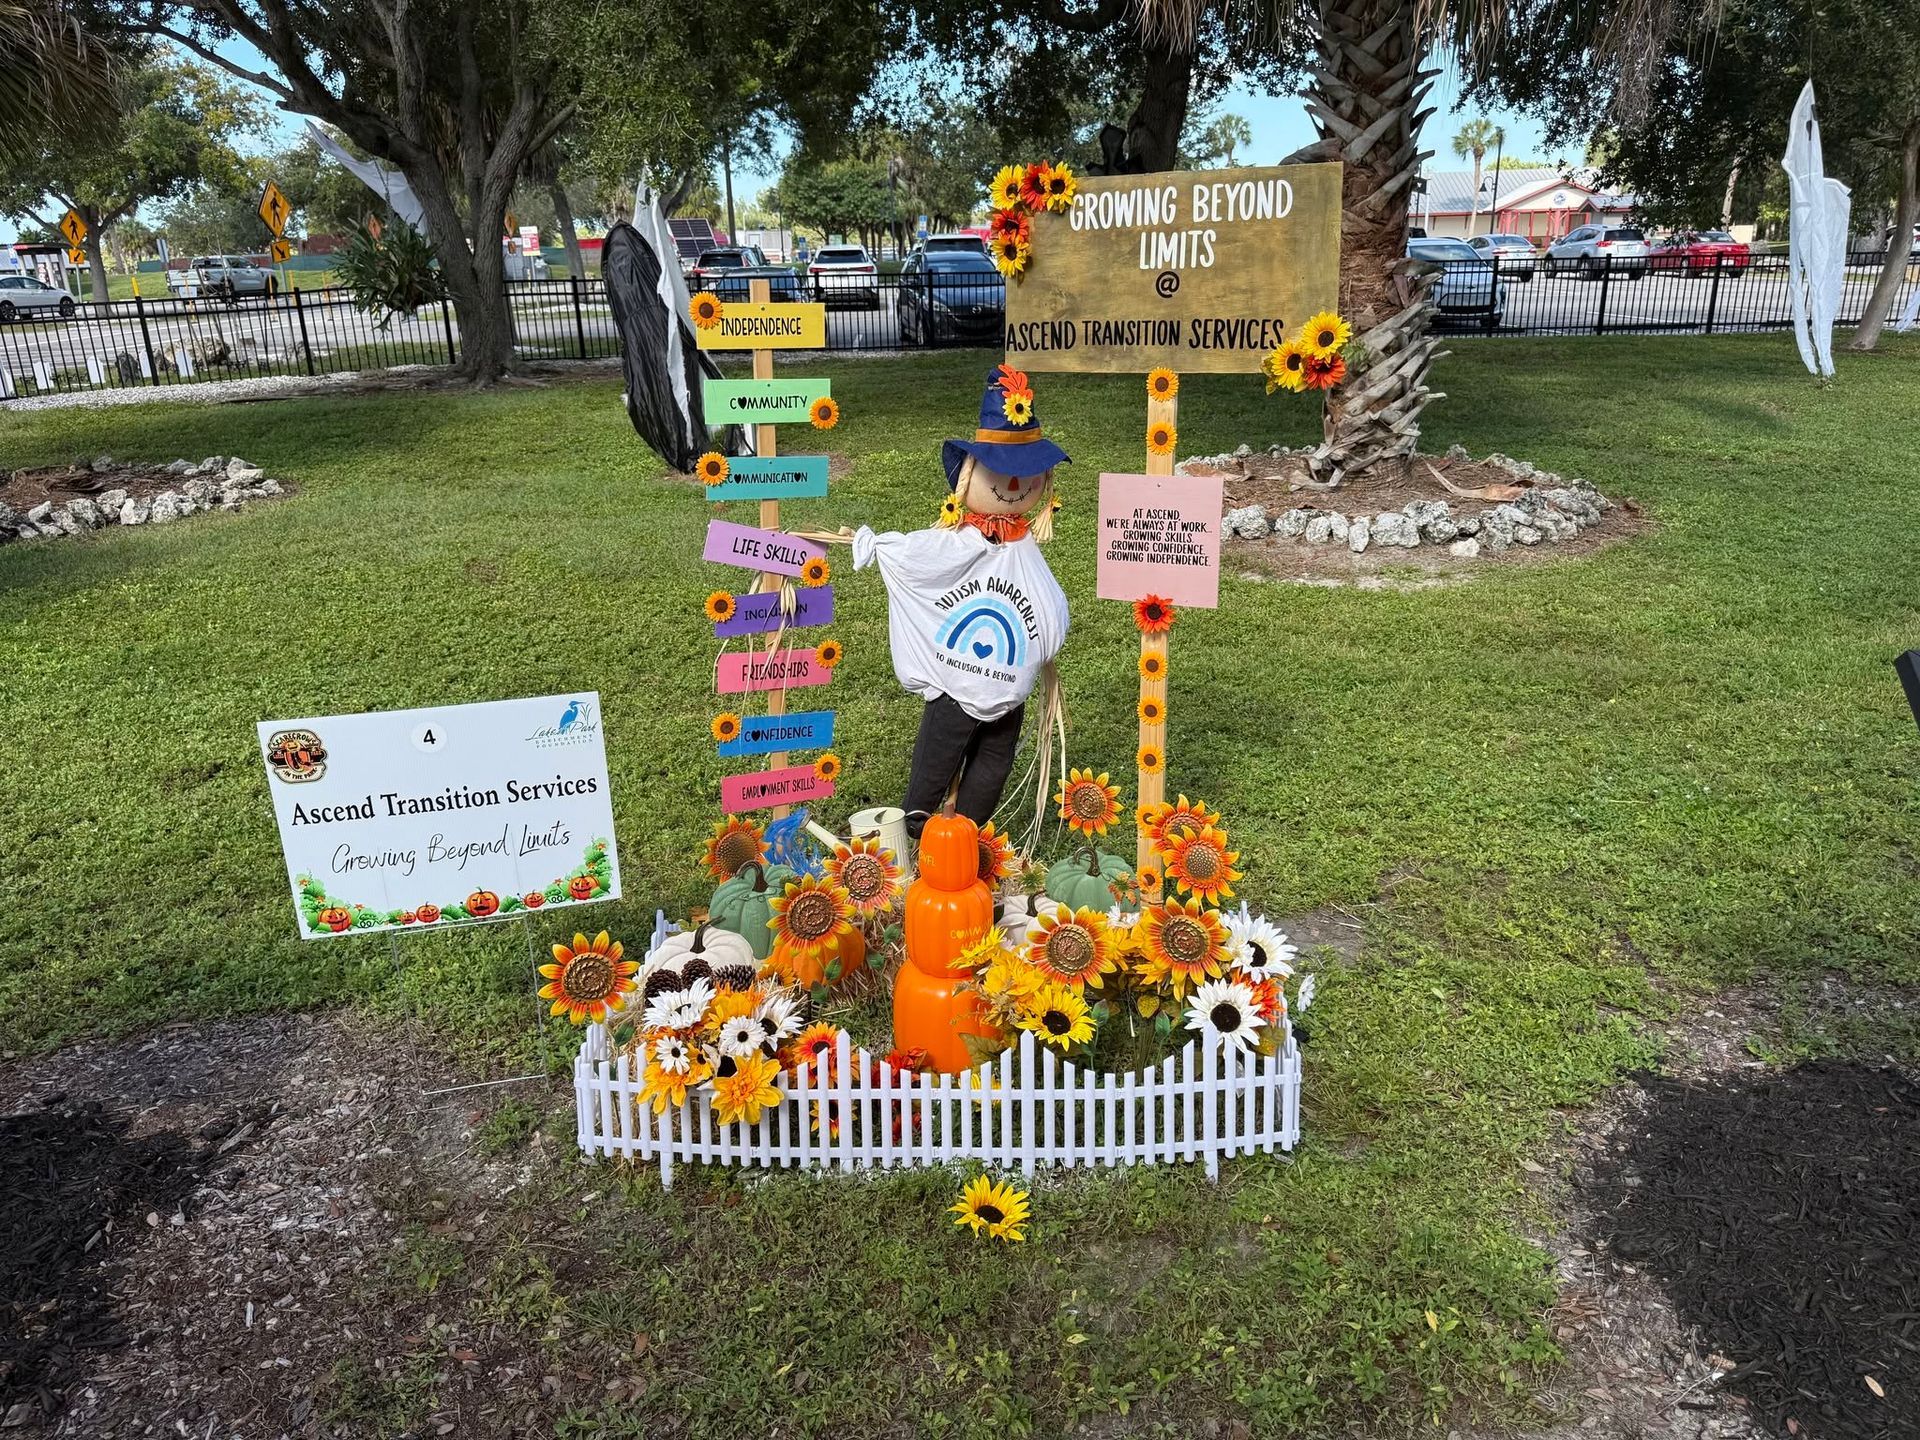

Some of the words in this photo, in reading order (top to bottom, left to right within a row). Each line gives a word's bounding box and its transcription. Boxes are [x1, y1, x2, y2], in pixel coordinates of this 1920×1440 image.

[1069, 185, 1177, 232] GROWING
[1193, 179, 1293, 224] BEYOND
[1139, 229, 1216, 270] LIMITS
[1155, 271, 1180, 298] @
[720, 317, 802, 336] INDEPENDENCE
[1005, 320, 1076, 351] ASCEND
[1082, 319, 1181, 348] TRANSITION
[1188, 318, 1285, 350] SERVICES
[1106, 518, 1130, 529] WE'RE
[1132, 520, 1164, 531] ALWAYS
[1167, 521, 1178, 531] AT
[1133, 508, 1143, 519] AT
[1111, 540, 1150, 552] GROWING
[1123, 530, 1162, 541] GROWING
[732, 537, 761, 557] LIFE
[763, 543, 807, 566] SKILLS
[1106, 550, 1144, 563] GROWING
[934, 579, 982, 611] AUTISM
[936, 652, 945, 662] TO
[946, 657, 983, 675] INCLUSION
[984, 668, 990, 677] &
[992, 671, 1017, 683] BEYOND
[423, 728, 437, 745] 4
[569, 721, 598, 733] Park
[792, 776, 815, 792] SKILLS
[291, 795, 375, 827] Ascend
[380, 785, 500, 818] Transition
[507, 774, 598, 803] Services
[330, 843, 417, 877] Growing
[428, 823, 510, 871] Beyond
[518, 820, 572, 858] Limits
